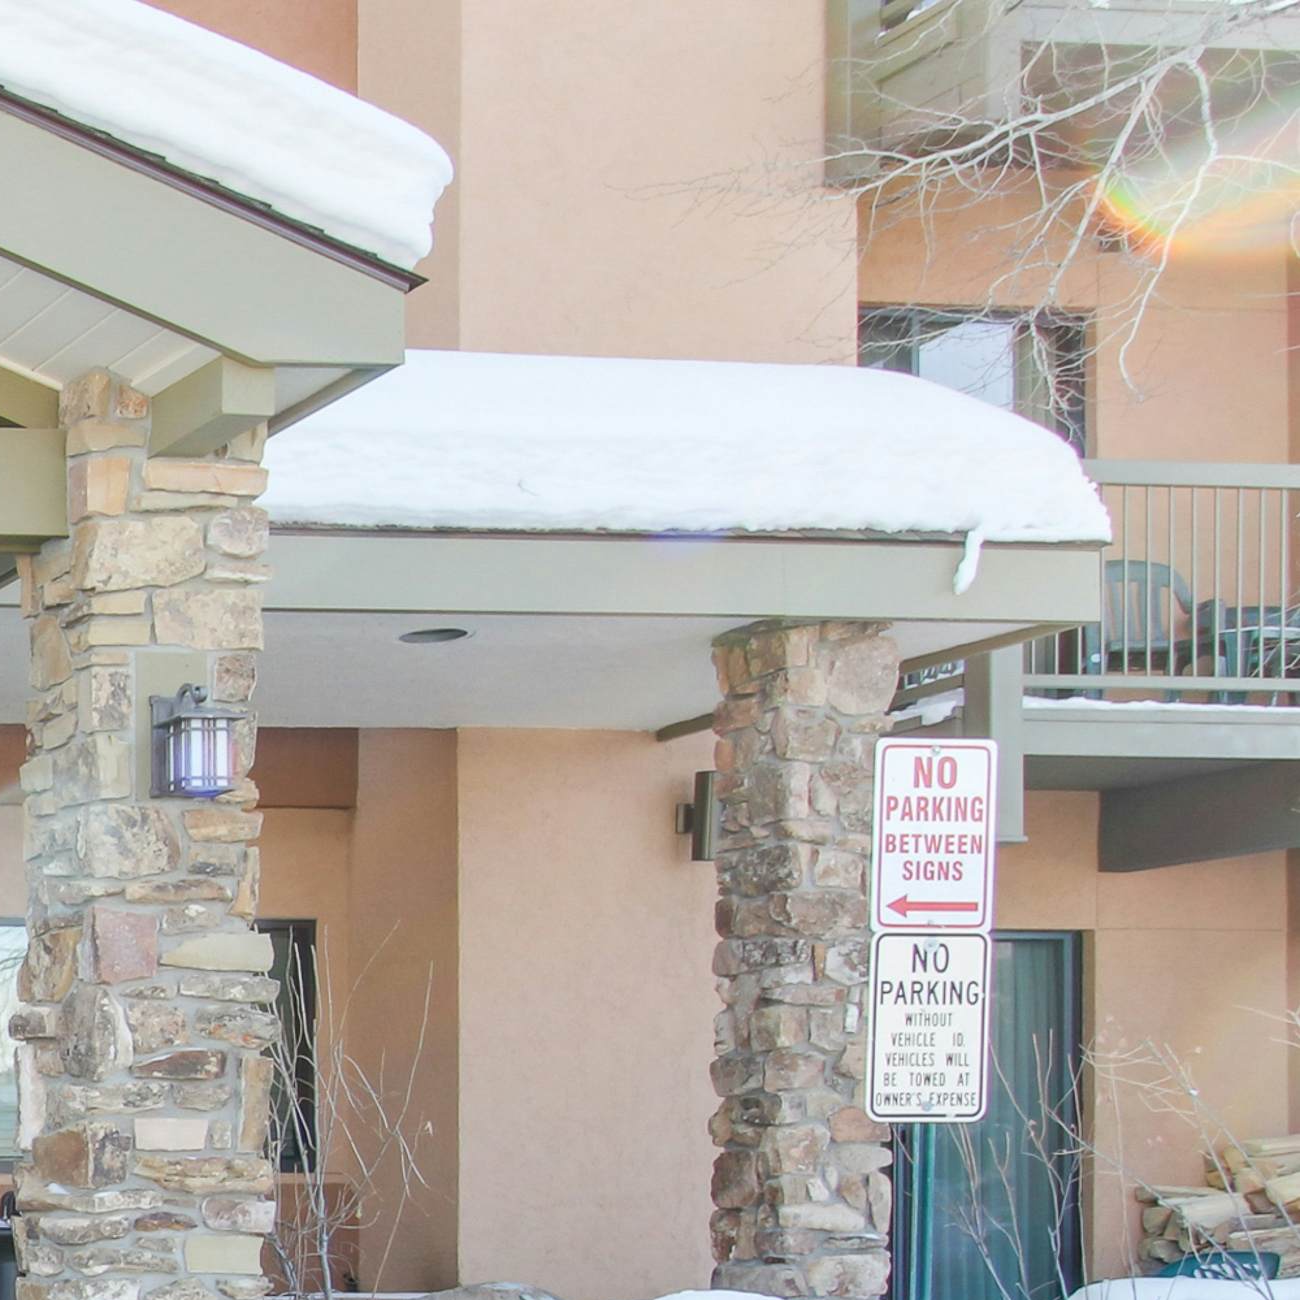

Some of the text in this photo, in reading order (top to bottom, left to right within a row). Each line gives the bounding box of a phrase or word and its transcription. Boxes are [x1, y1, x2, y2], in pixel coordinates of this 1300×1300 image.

[913, 756, 958, 789] NO
[886, 795, 984, 822] PARKING
[885, 833, 983, 854] BETWEEN
[902, 860, 963, 881] SIGNS
[911, 943, 950, 973] NO
[880, 980, 979, 1005] PARKING
[905, 1012, 952, 1027] WITHOUT
[890, 1032, 935, 1047] VEHICLE
[885, 1052, 969, 1067] VEHICLES WILL
[883, 1072, 970, 1087] BE TOWED AT
[875, 1092, 977, 1107] OWNER'S EXPENSE
